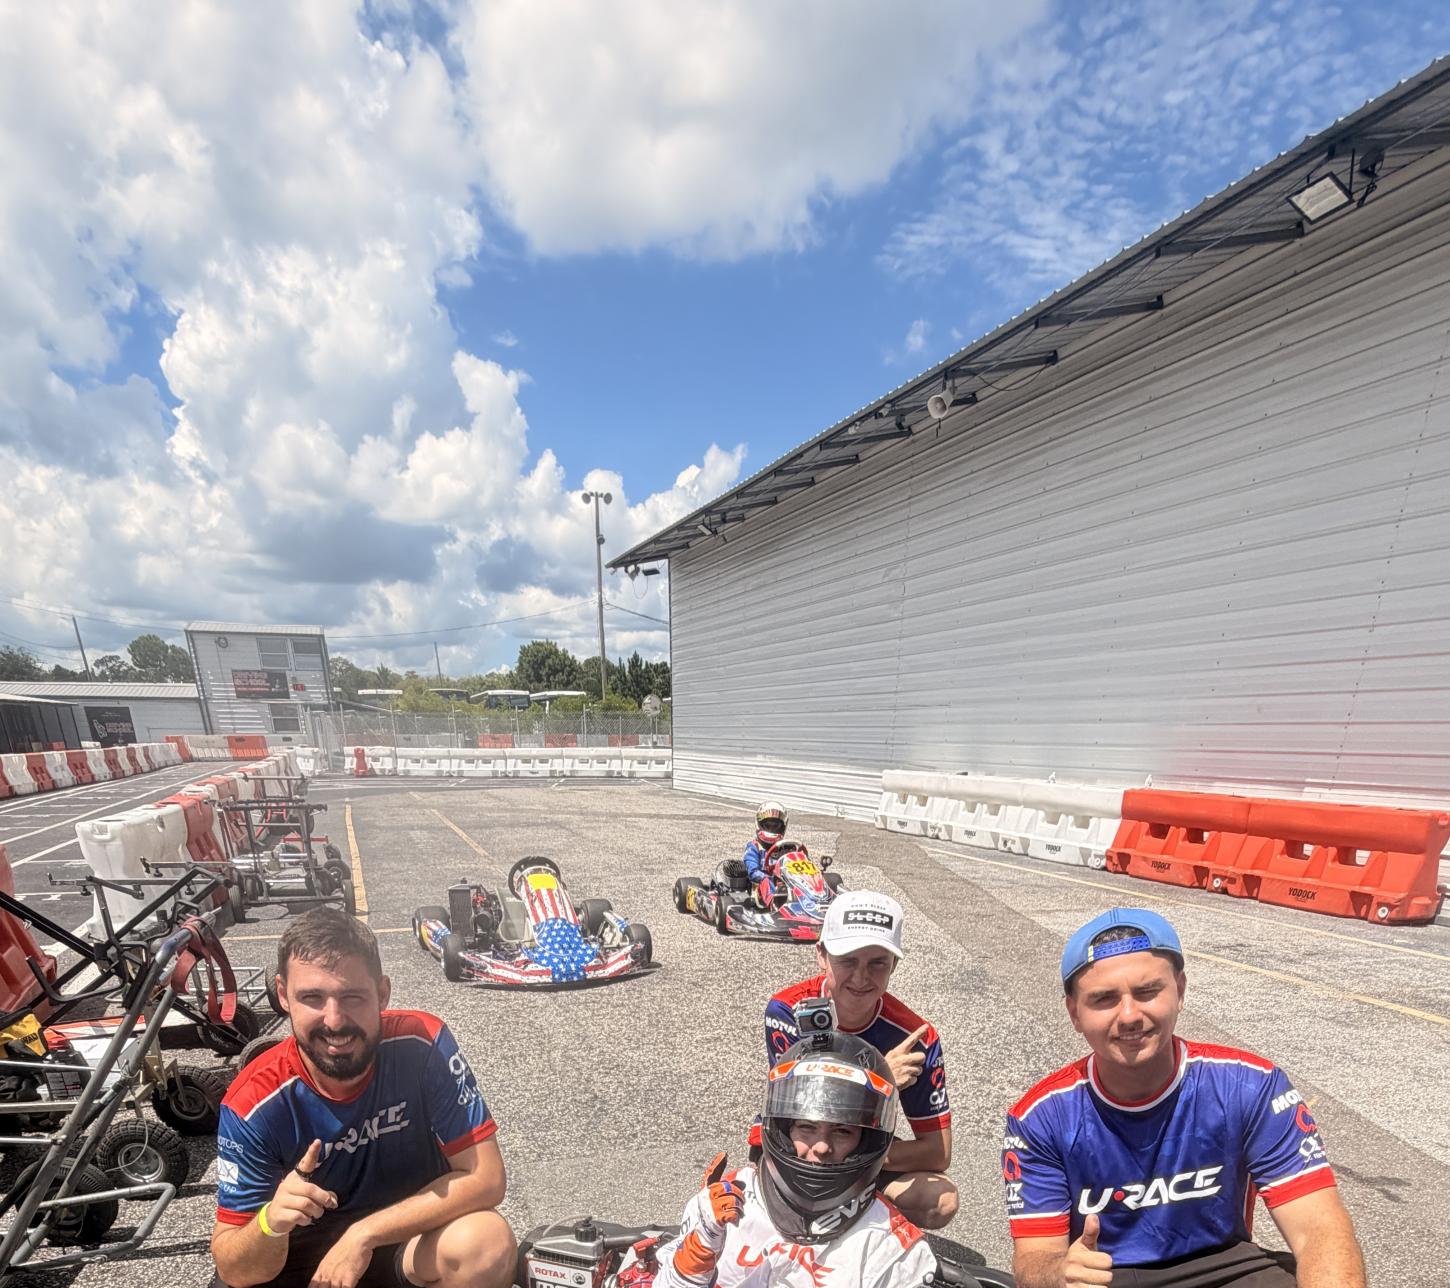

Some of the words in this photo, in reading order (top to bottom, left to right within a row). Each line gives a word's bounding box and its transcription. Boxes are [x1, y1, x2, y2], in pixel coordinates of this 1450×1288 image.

[1151, 861, 1171, 870] YODOCK
[1288, 887, 1317, 900] YODOCK
[848, 912, 890, 925] SLEEP
[765, 1016, 798, 1037] MOTUL
[534, 1267, 567, 1280] ROTAX
